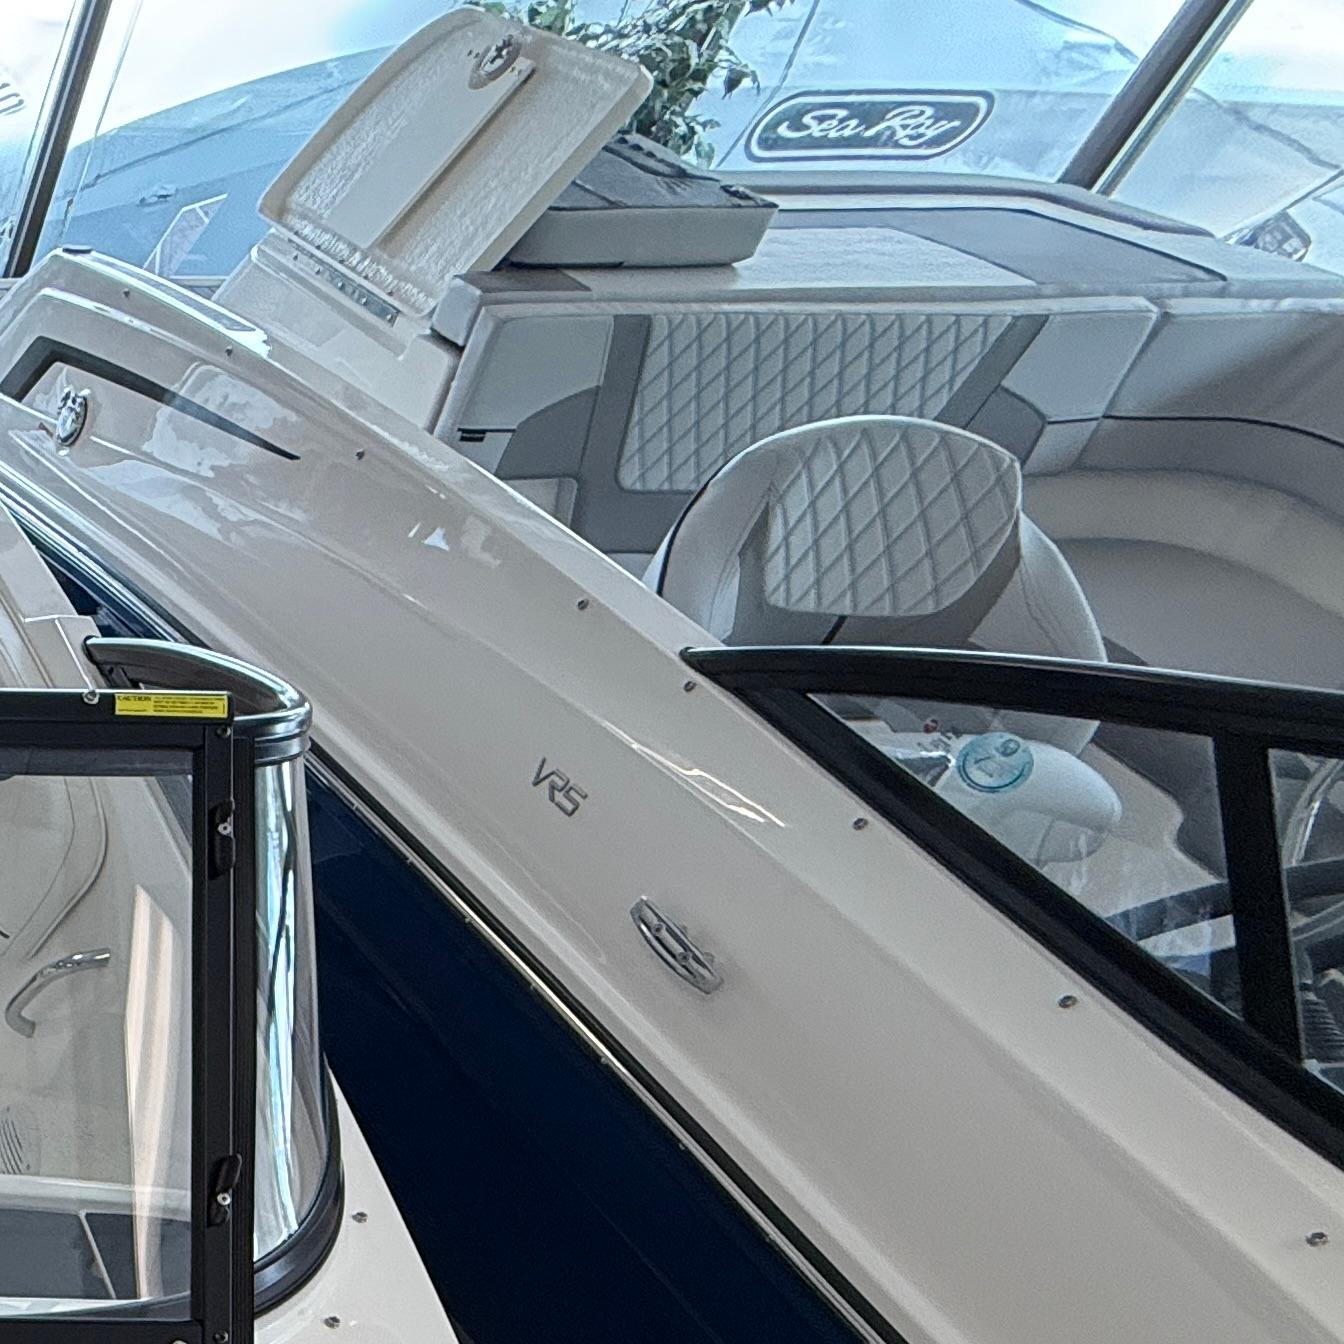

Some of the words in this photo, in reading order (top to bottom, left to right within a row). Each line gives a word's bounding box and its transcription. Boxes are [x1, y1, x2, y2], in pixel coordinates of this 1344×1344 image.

[777, 108, 864, 138] Sea
[862, 105, 961, 146] Ray
[532, 757, 588, 817] VRS
